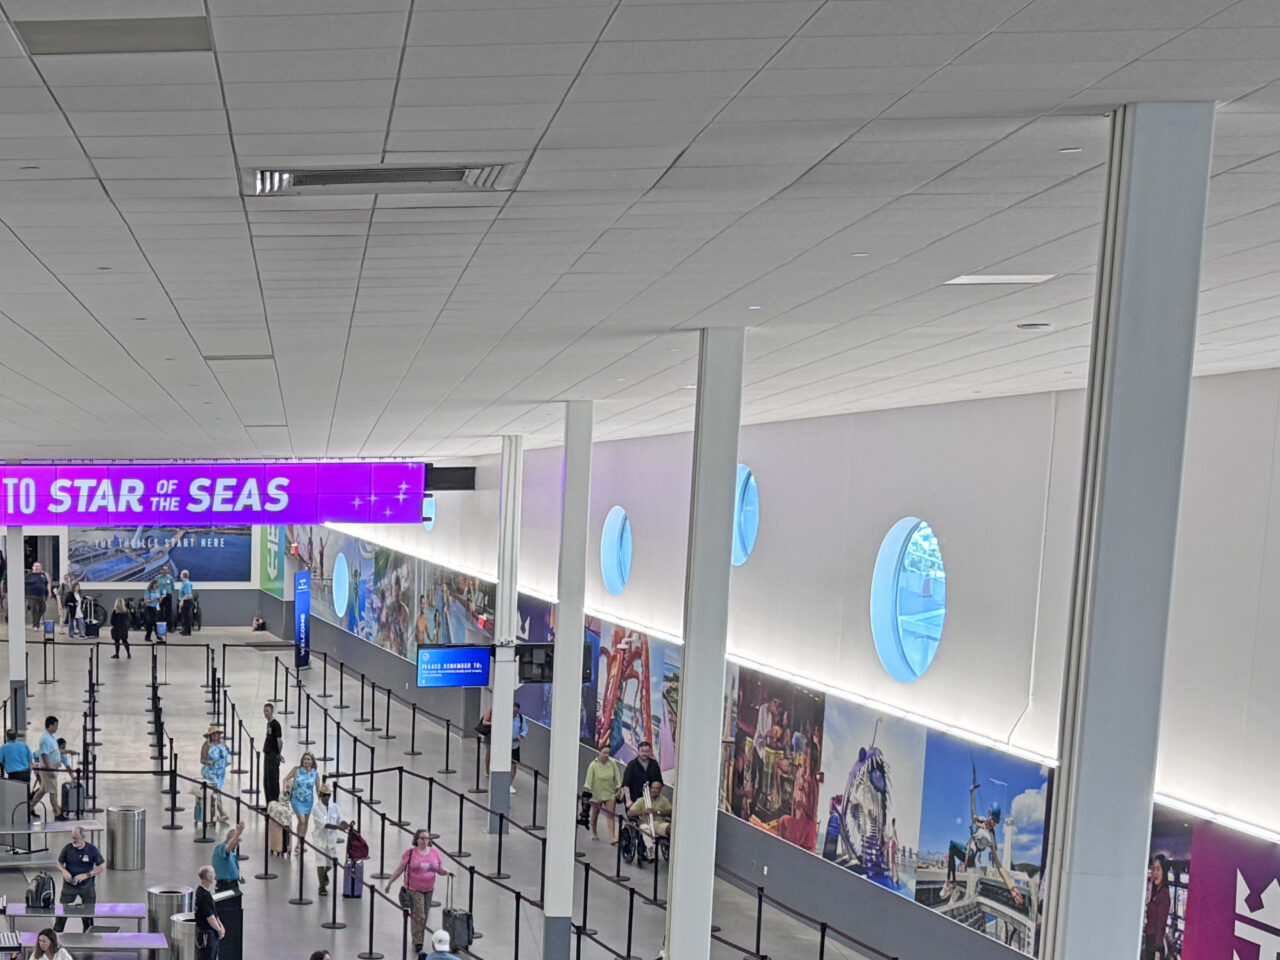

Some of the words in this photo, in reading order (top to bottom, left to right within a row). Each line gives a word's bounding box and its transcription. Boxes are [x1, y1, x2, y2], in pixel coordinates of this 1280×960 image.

[2, 478, 36, 514] TO
[47, 479, 145, 512] STAR
[156, 480, 178, 494] OF
[186, 477, 290, 512] SEAS
[150, 497, 180, 511] THE
[165, 538, 195, 548] START
[201, 538, 225, 547] HERE
